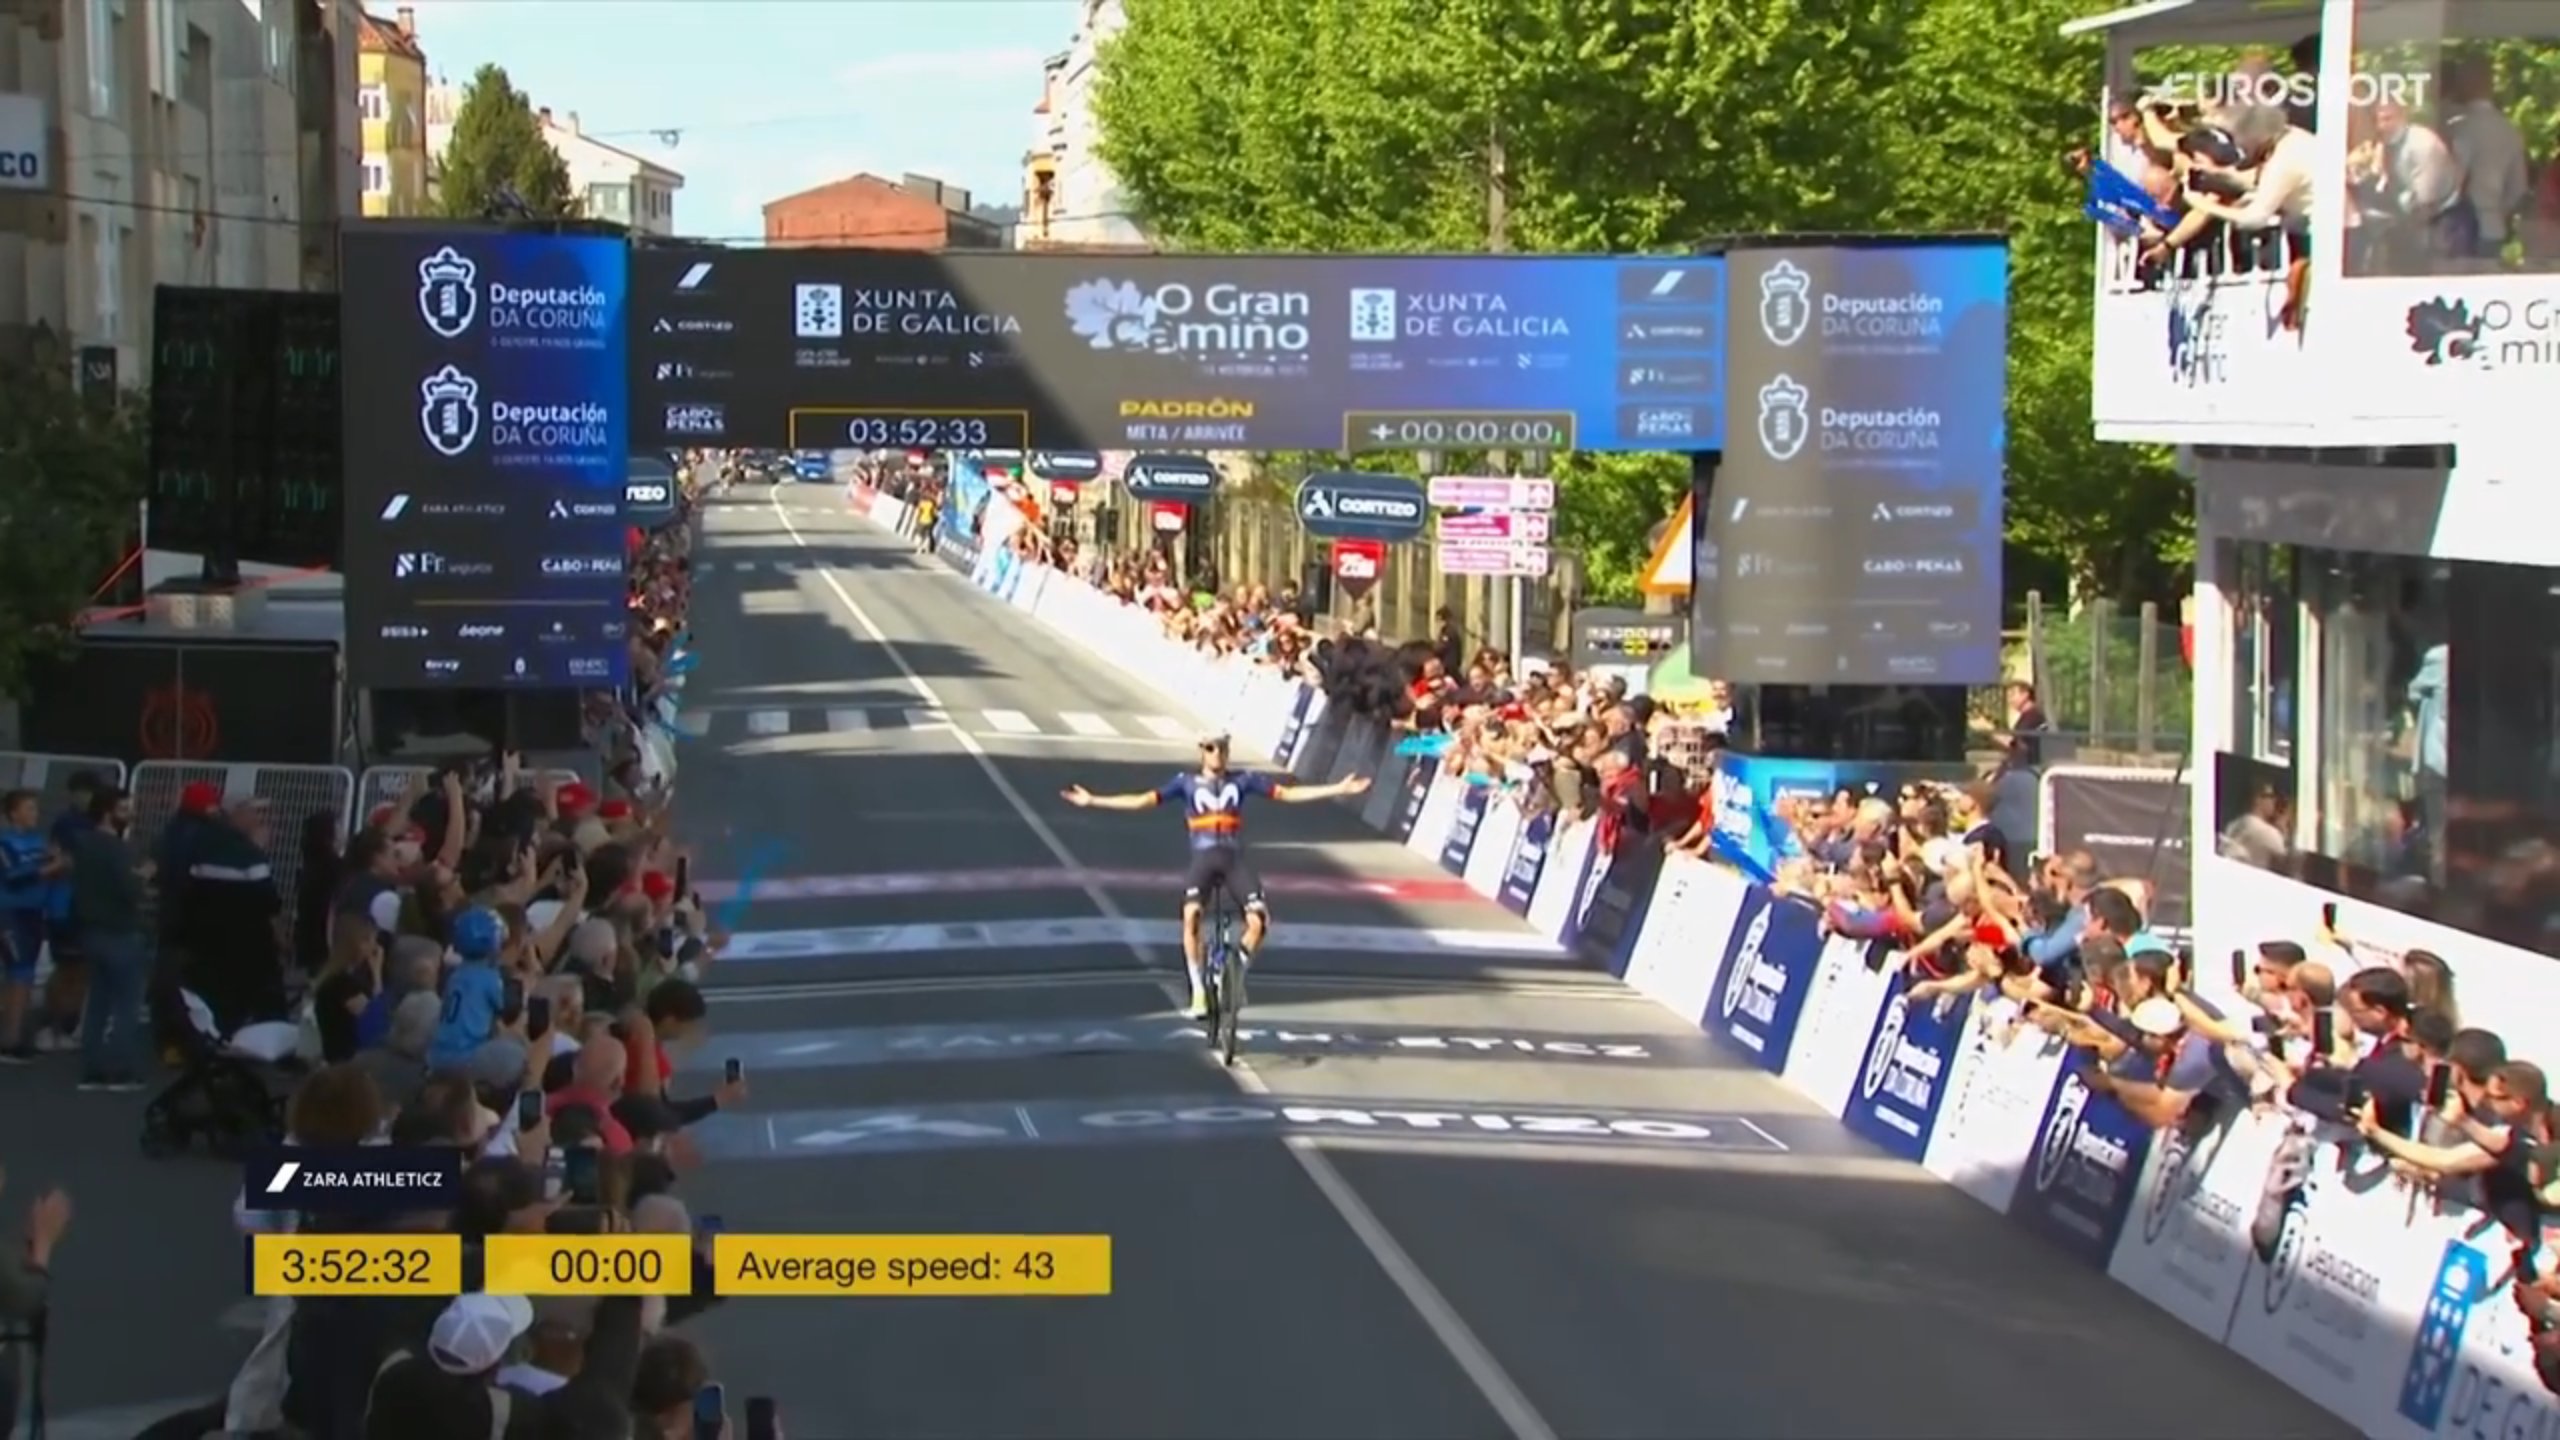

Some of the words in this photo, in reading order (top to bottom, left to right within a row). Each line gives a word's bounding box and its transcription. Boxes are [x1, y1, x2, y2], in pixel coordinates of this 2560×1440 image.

[490, 282, 606, 309] Deputación
[853, 289, 957, 309] XUNTA
[1156, 283, 1193, 316] O
[1205, 283, 1310, 317] Gran
[1406, 293, 1508, 313] XUNTA
[1822, 292, 1944, 318] Deputación
[490, 307, 521, 328] DA
[526, 305, 606, 329] CORUÑA
[853, 314, 890, 334] DE
[900, 314, 1022, 335] GALICIA
[1405, 317, 1442, 337] DE
[1452, 316, 1570, 337] GALICIA
[1821, 317, 1850, 336] DA
[1855, 314, 1942, 337] CORUÑA
[2483, 299, 2513, 331] O
[491, 401, 608, 427] Deputación
[1119, 397, 1254, 418] PADRÓN
[1820, 406, 1940, 432] Deputación
[492, 425, 522, 446] DA
[527, 423, 607, 446] CORUÑA
[848, 419, 987, 445] 03:52:33
[1126, 424, 1168, 441] META
[1820, 430, 1850, 450] DA
[1854, 427, 1940, 450] CORUÑA
[1338, 497, 1418, 518] CORTIZO
[1077, 1104, 1712, 1138] CORTIZO
